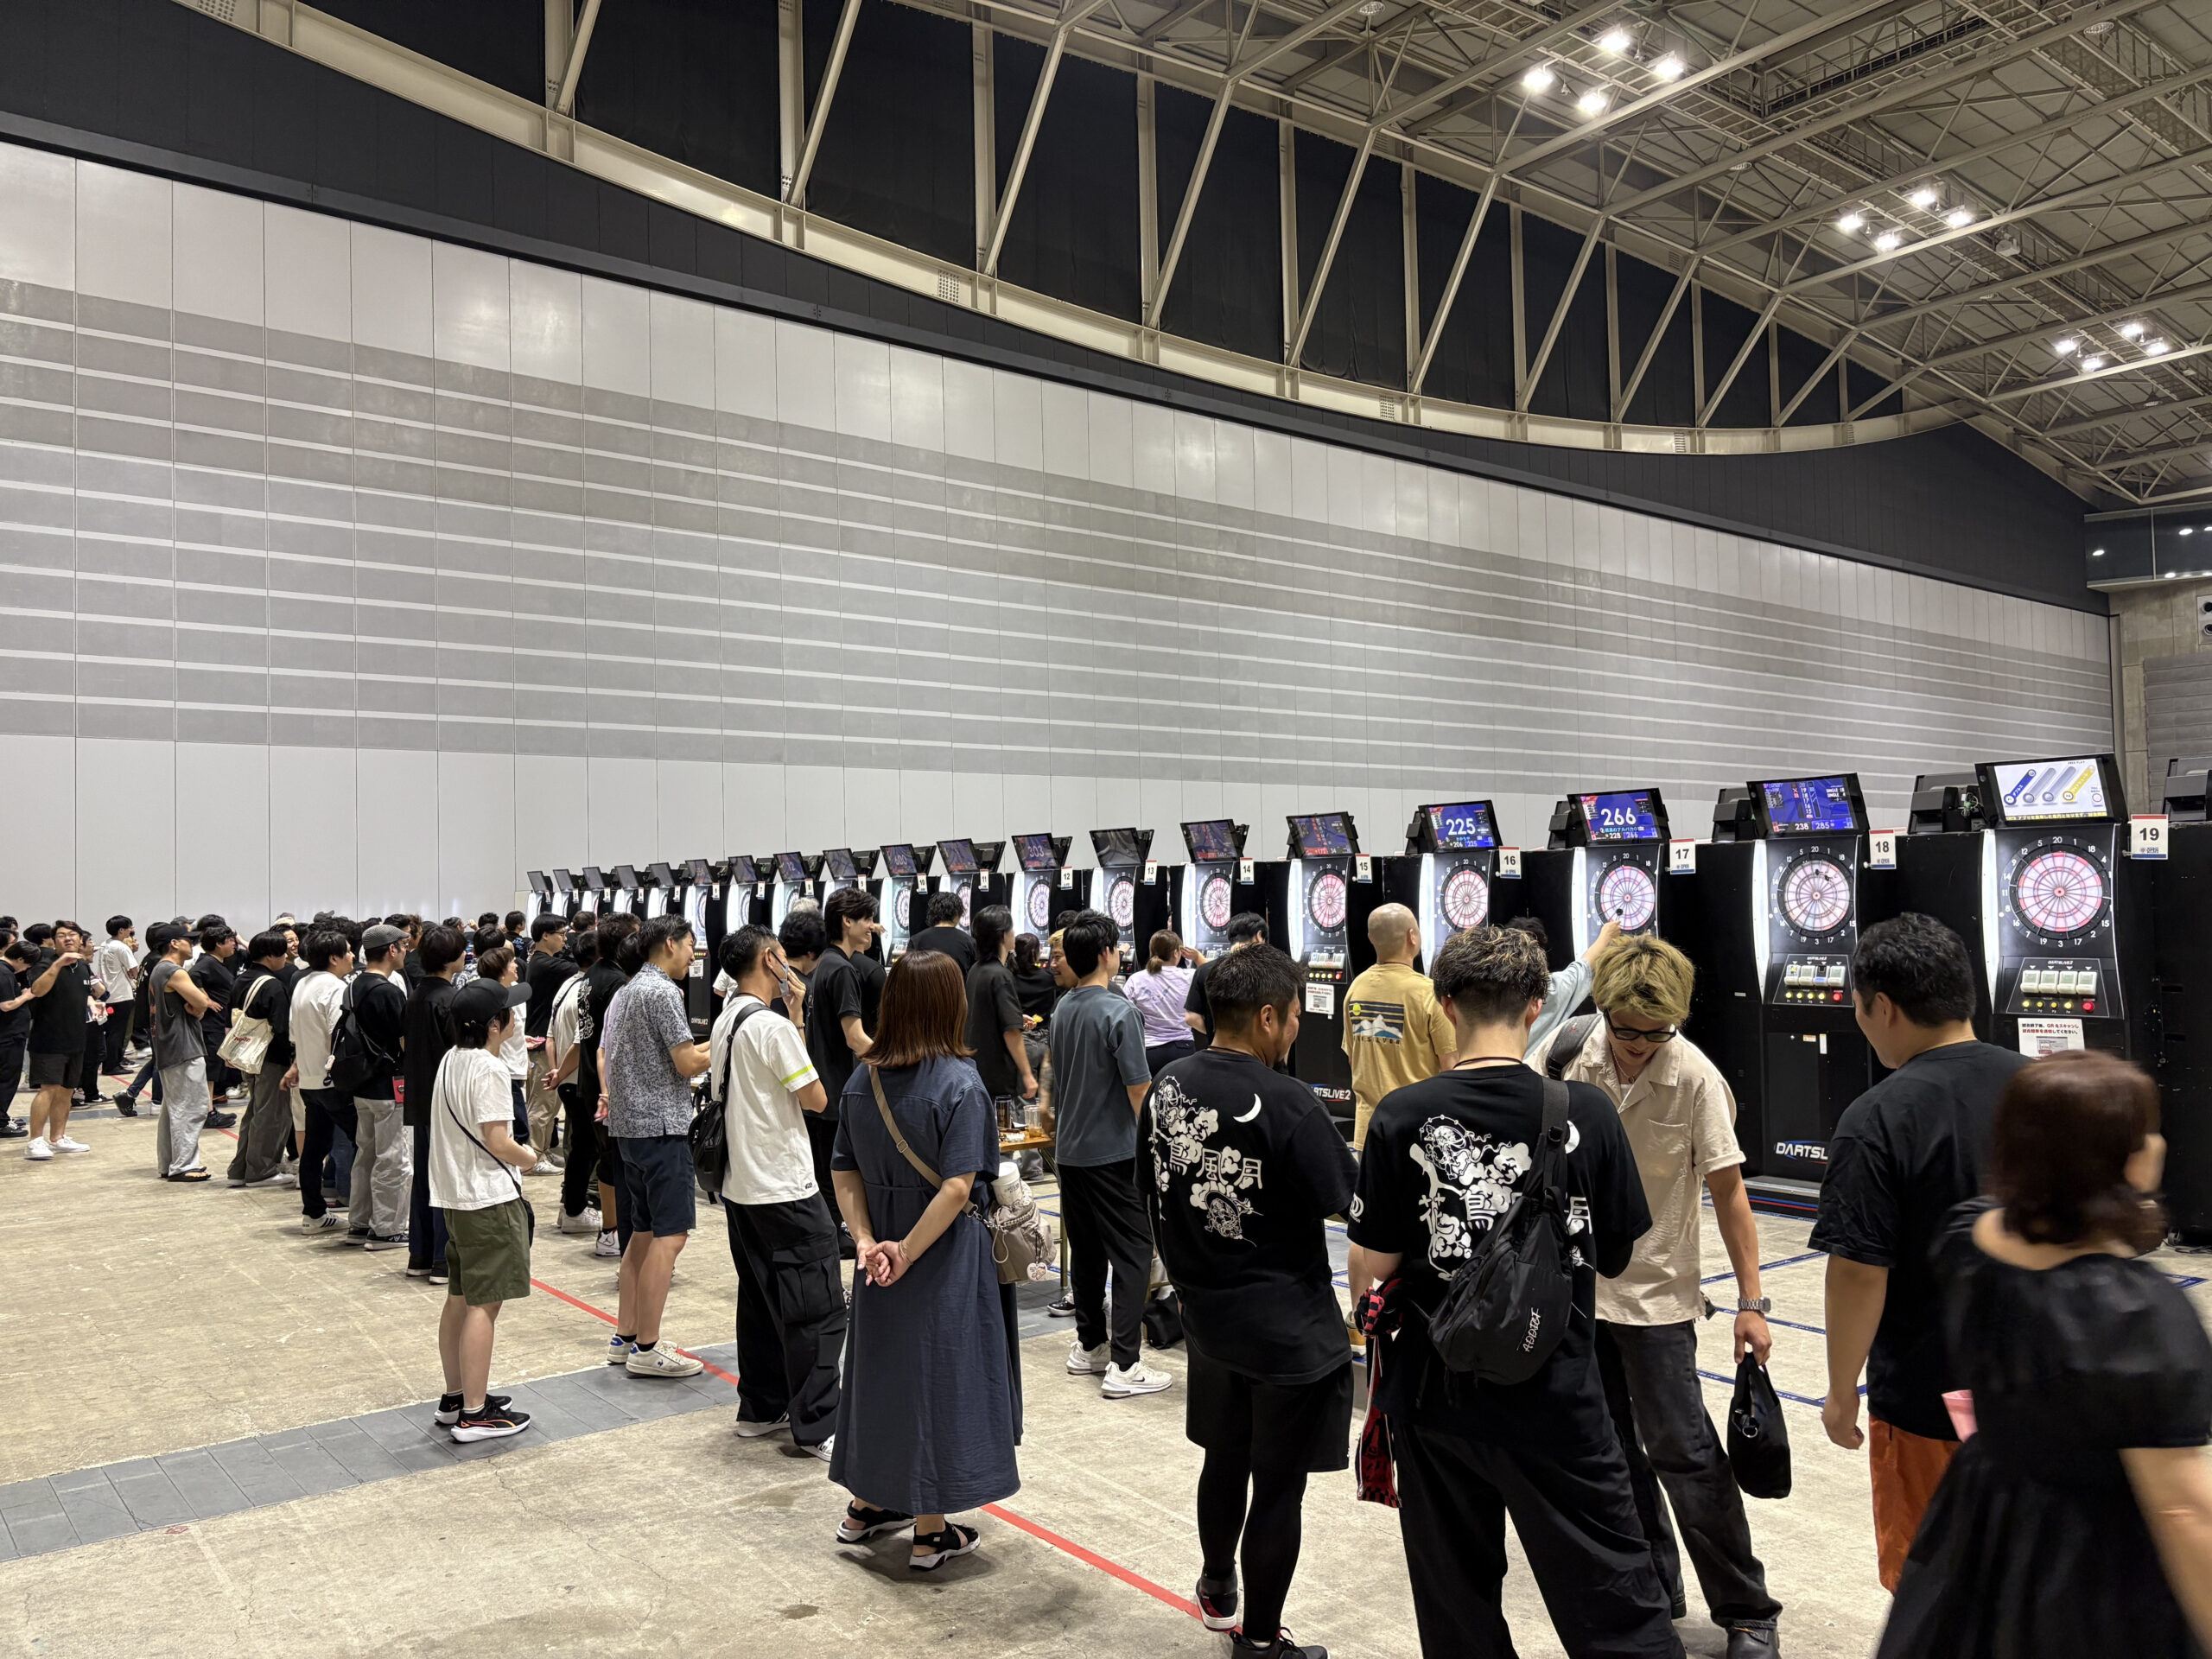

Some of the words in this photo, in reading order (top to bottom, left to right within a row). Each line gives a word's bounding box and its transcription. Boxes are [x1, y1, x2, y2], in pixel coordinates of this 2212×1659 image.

[1600, 807, 1637, 826] 266
[1446, 818, 1476, 836] 225
[2139, 827, 2159, 841] 19
[1875, 841, 1890, 853] 18
[1504, 855, 1516, 865] 16
[1675, 849, 1689, 860] 17
[1243, 865, 1250, 874] 14
[1359, 862, 1369, 871] 15
